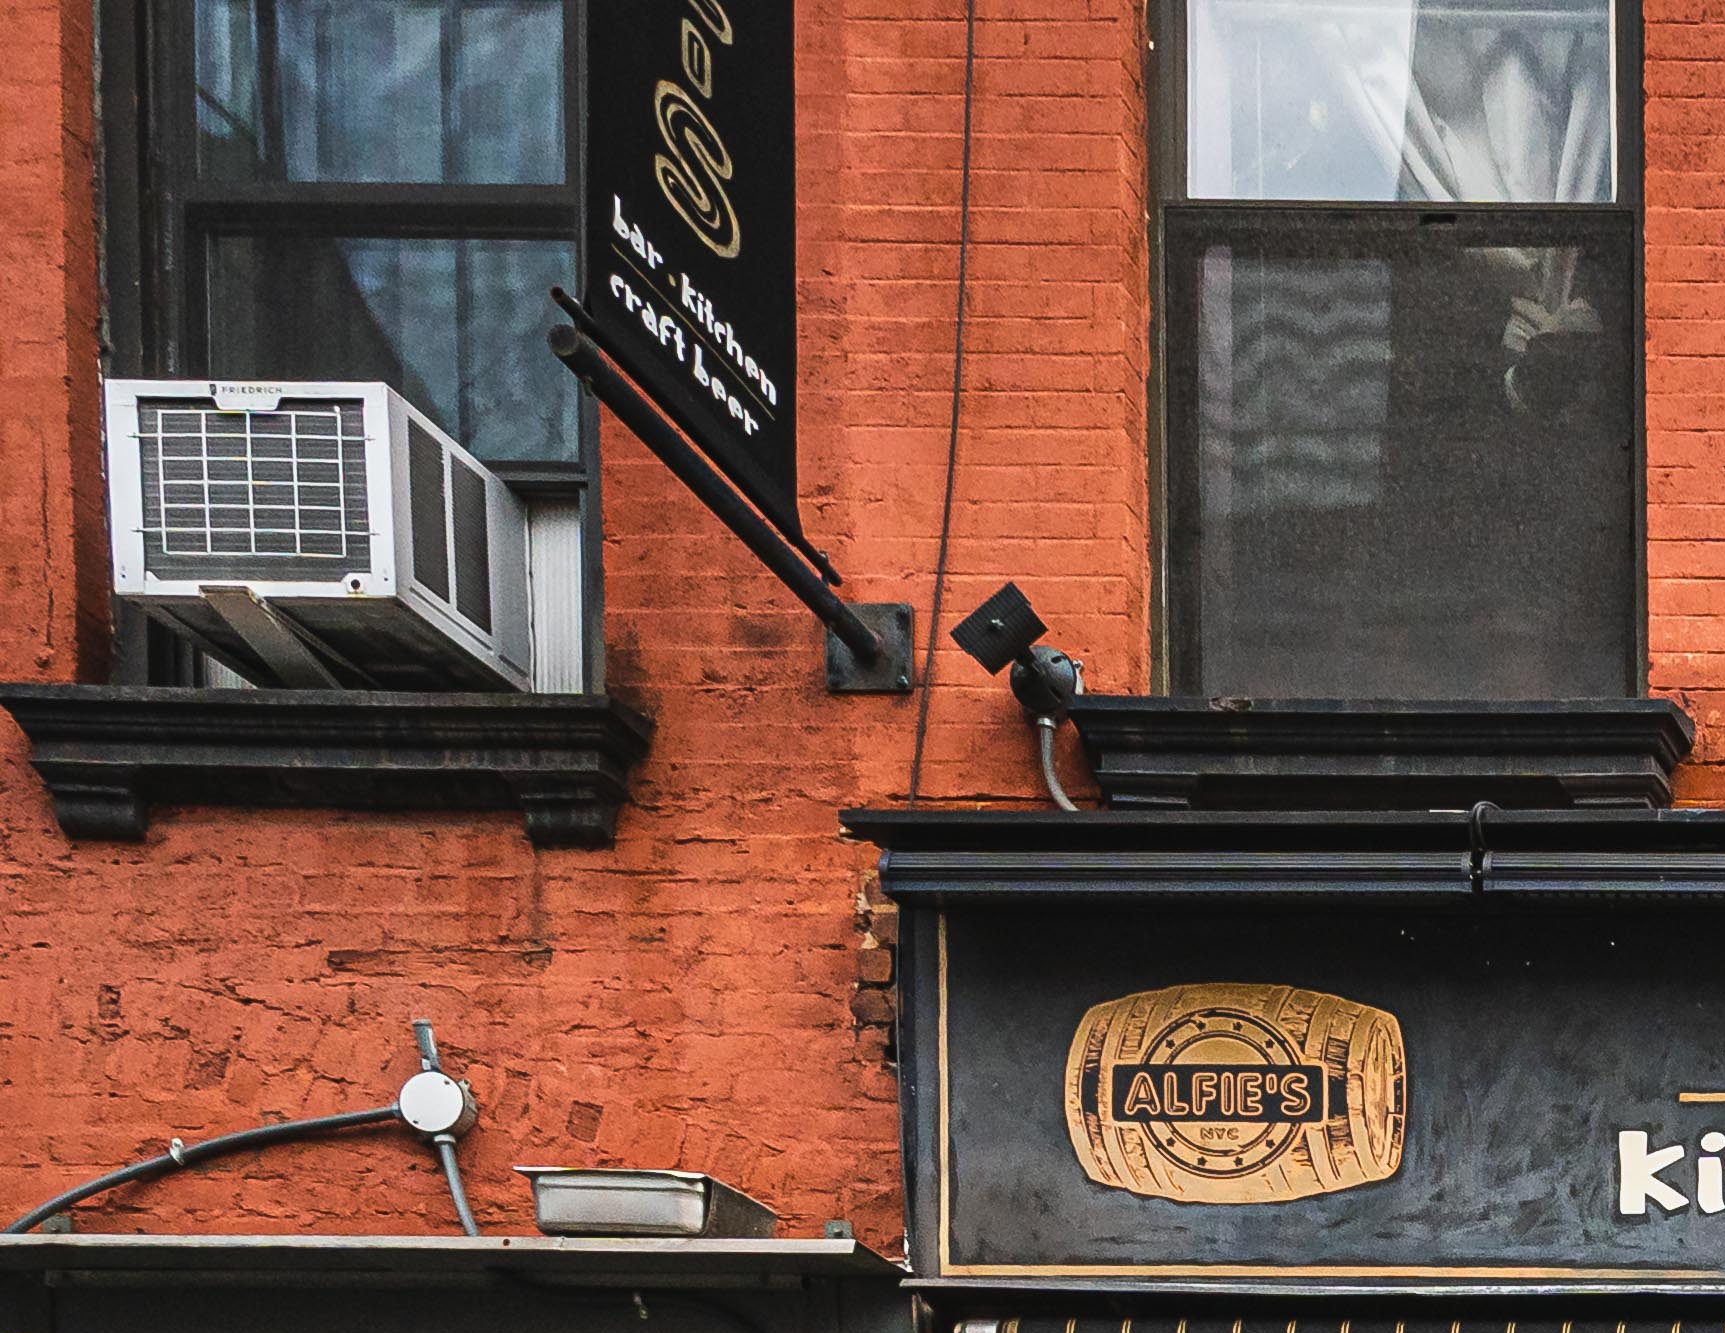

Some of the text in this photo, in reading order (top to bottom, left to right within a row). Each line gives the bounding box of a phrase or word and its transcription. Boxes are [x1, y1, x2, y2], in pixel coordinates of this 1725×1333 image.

[612, 193, 778, 407] bar kitchen
[609, 273, 760, 437] craft beer
[221, 385, 283, 395] FRIEDRICH
[1123, 1070, 1313, 1117] ALFIE'S
[1199, 1126, 1240, 1141] NYC
